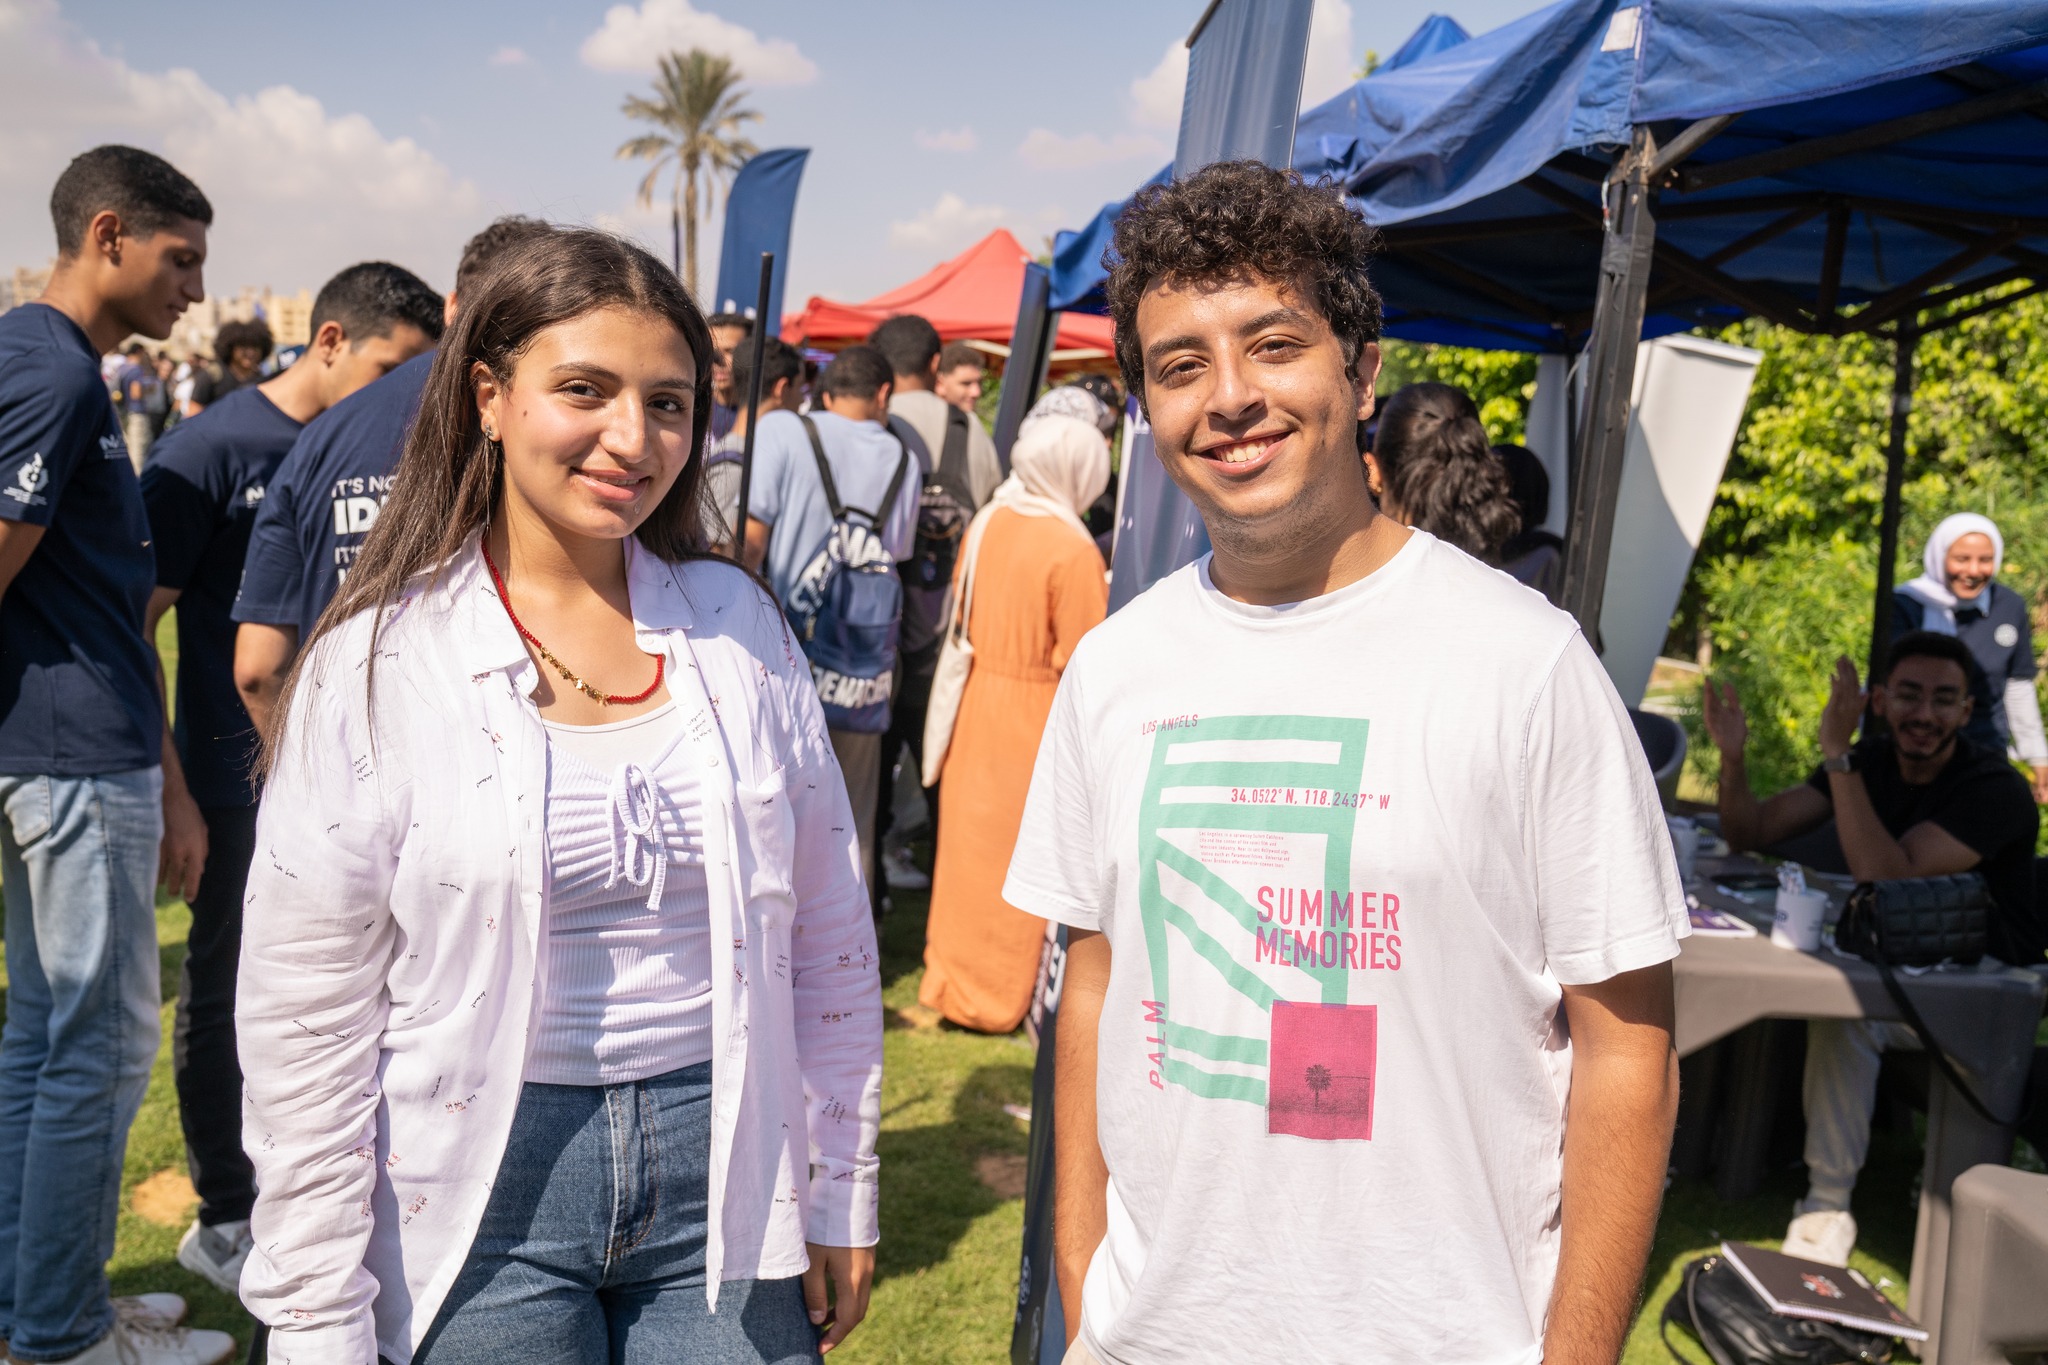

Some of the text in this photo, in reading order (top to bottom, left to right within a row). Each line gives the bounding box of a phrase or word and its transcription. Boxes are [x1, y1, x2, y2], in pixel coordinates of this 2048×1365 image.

[331, 477, 364, 498] IT'S
[1142, 720, 1158, 736] LOS
[1304, 789, 1374, 808] 118.2437°
[1380, 794, 1390, 810] W
[1257, 886, 1400, 931] SUMMER
[1255, 926, 1402, 971] MEMORIES
[1141, 999, 1166, 1091] PALM
